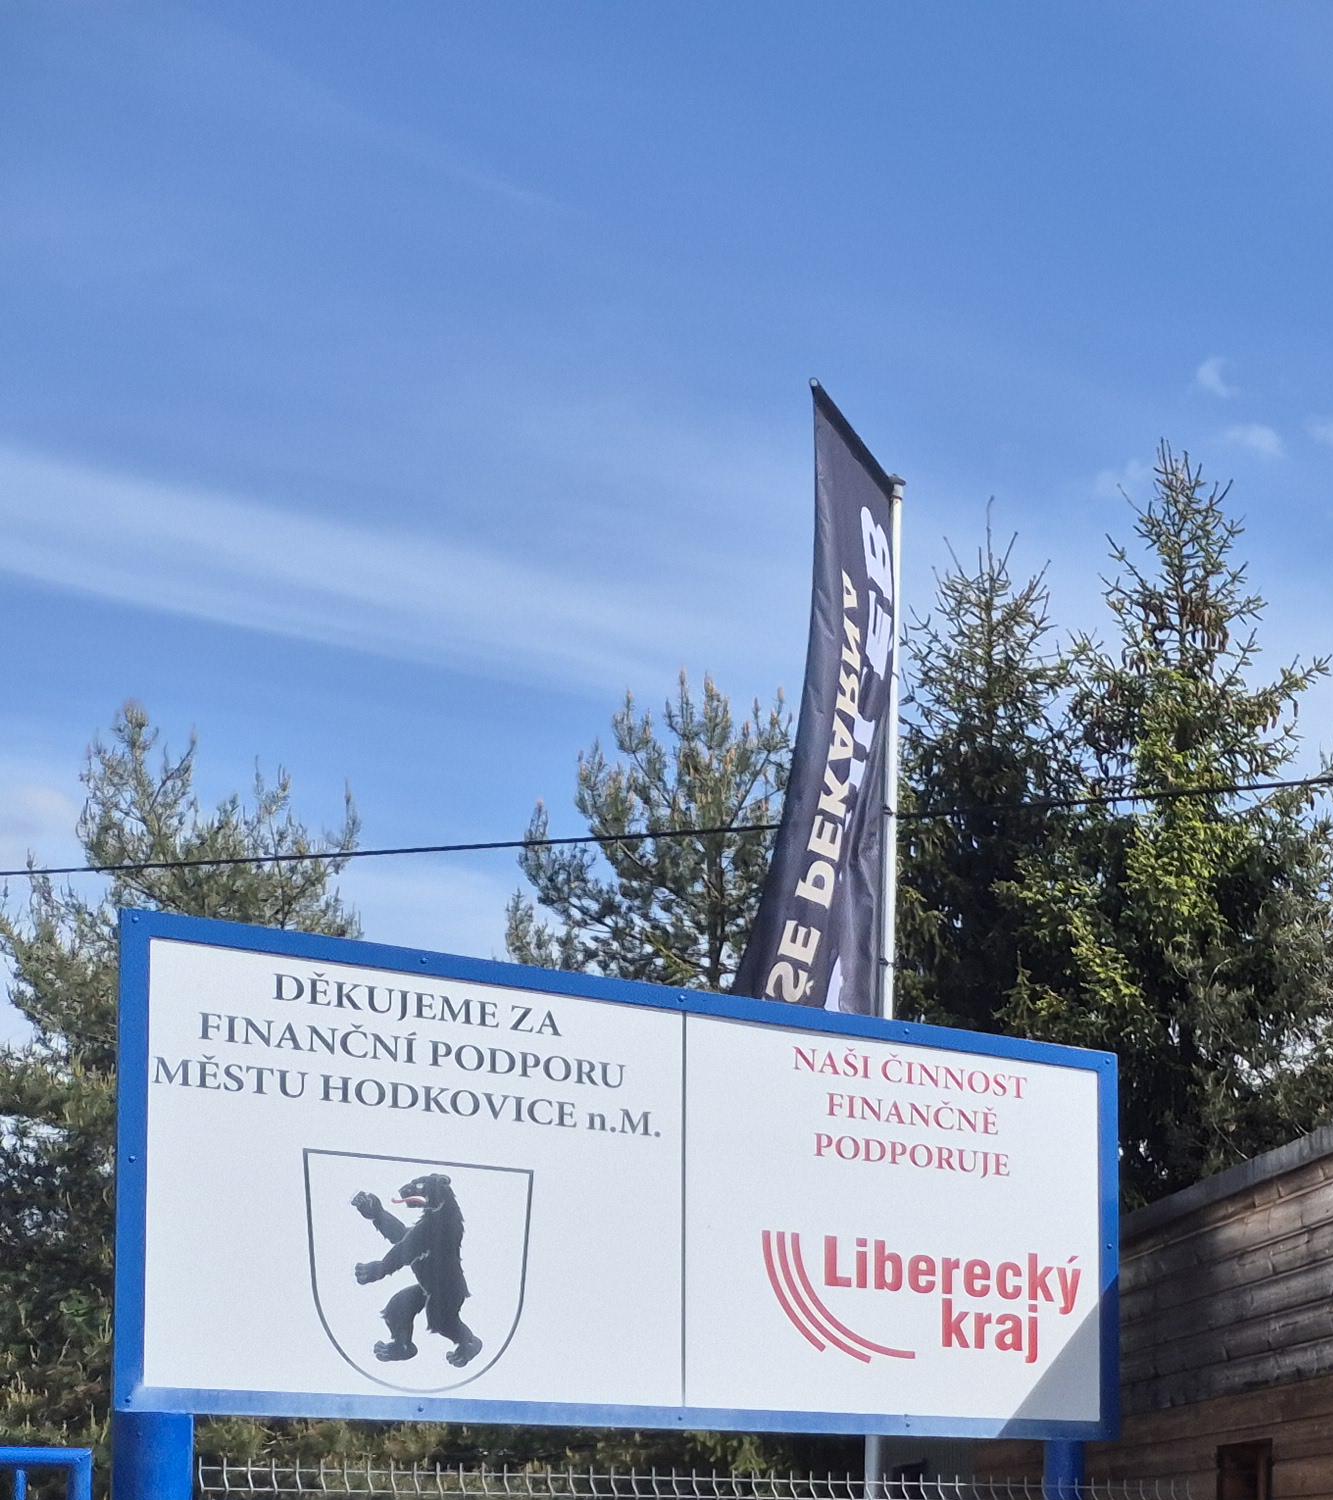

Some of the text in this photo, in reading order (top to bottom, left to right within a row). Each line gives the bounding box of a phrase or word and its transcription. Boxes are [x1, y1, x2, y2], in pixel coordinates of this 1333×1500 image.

[274, 972, 562, 1037] DĚKUJEME ZA
[198, 1013, 625, 1088] FINANČNÍ PODPORU
[791, 1044, 1028, 1099] NAŠI ČINNOST
[152, 1051, 661, 1138] MĚSTU HODKOVICE n.M.
[826, 1091, 1000, 1136] FINANČNĚ
[813, 1132, 1011, 1178] PODPORUJE
[823, 1235, 1082, 1315] Liberecký
[941, 1297, 1040, 1364] kraj
